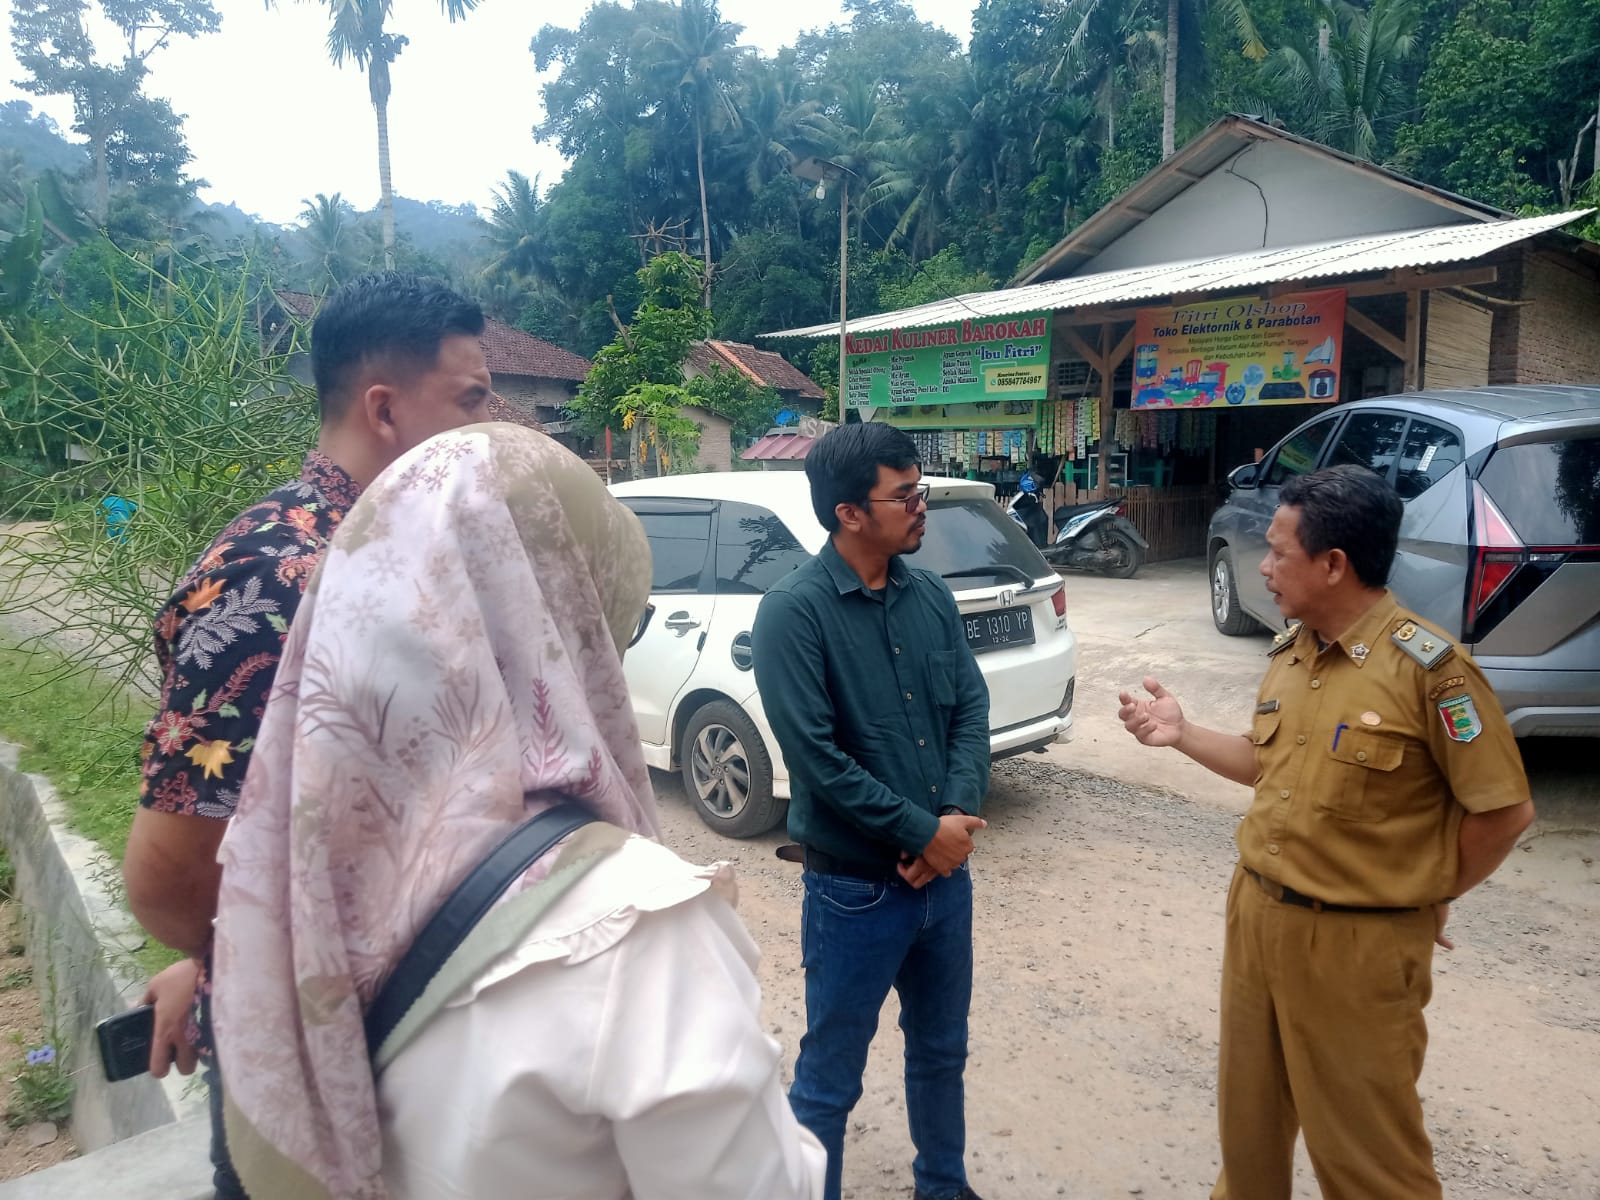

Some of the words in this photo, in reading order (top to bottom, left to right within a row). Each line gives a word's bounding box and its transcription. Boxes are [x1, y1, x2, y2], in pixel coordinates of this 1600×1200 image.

[1174, 307, 1218, 323] Fitri
[1226, 301, 1306, 319] Olshop
[845, 333, 888, 354] KEDAI
[891, 327, 958, 350] KULINER
[961, 318, 1046, 343] BAROKAH
[1153, 327, 1178, 337] Toko
[1181, 320, 1240, 335] Elektornik
[1244, 319, 1253, 330] &
[1258, 315, 1321, 328] Parabotan
[966, 619, 981, 640] BE
[986, 615, 1011, 636] 1310
[1015, 611, 1028, 631] YP
